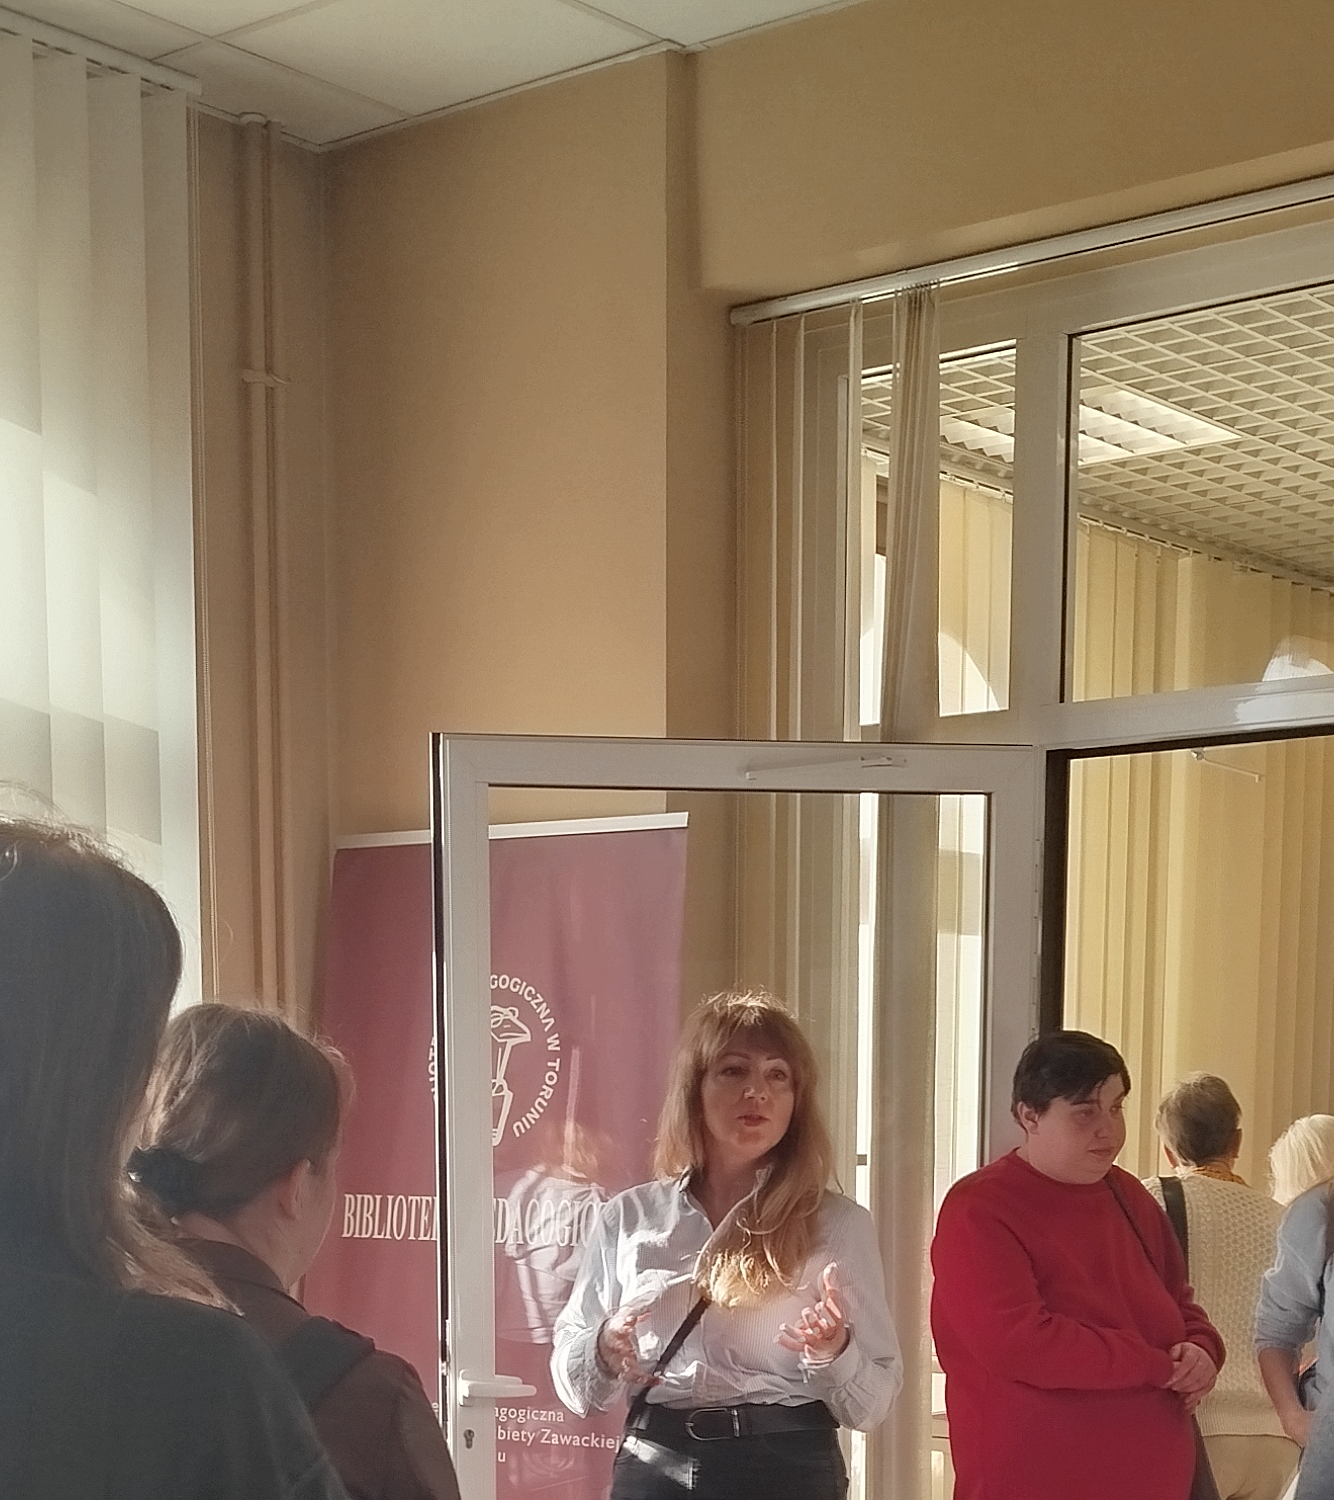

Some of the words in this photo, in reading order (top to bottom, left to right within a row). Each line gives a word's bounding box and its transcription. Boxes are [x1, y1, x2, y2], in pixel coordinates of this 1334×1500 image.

[546, 1033, 561, 1051] W
[512, 1057, 561, 1138] TORUNIU
[493, 1197, 604, 1247] DAGOGIC
[540, 1428, 620, 1454] Zawackiej
